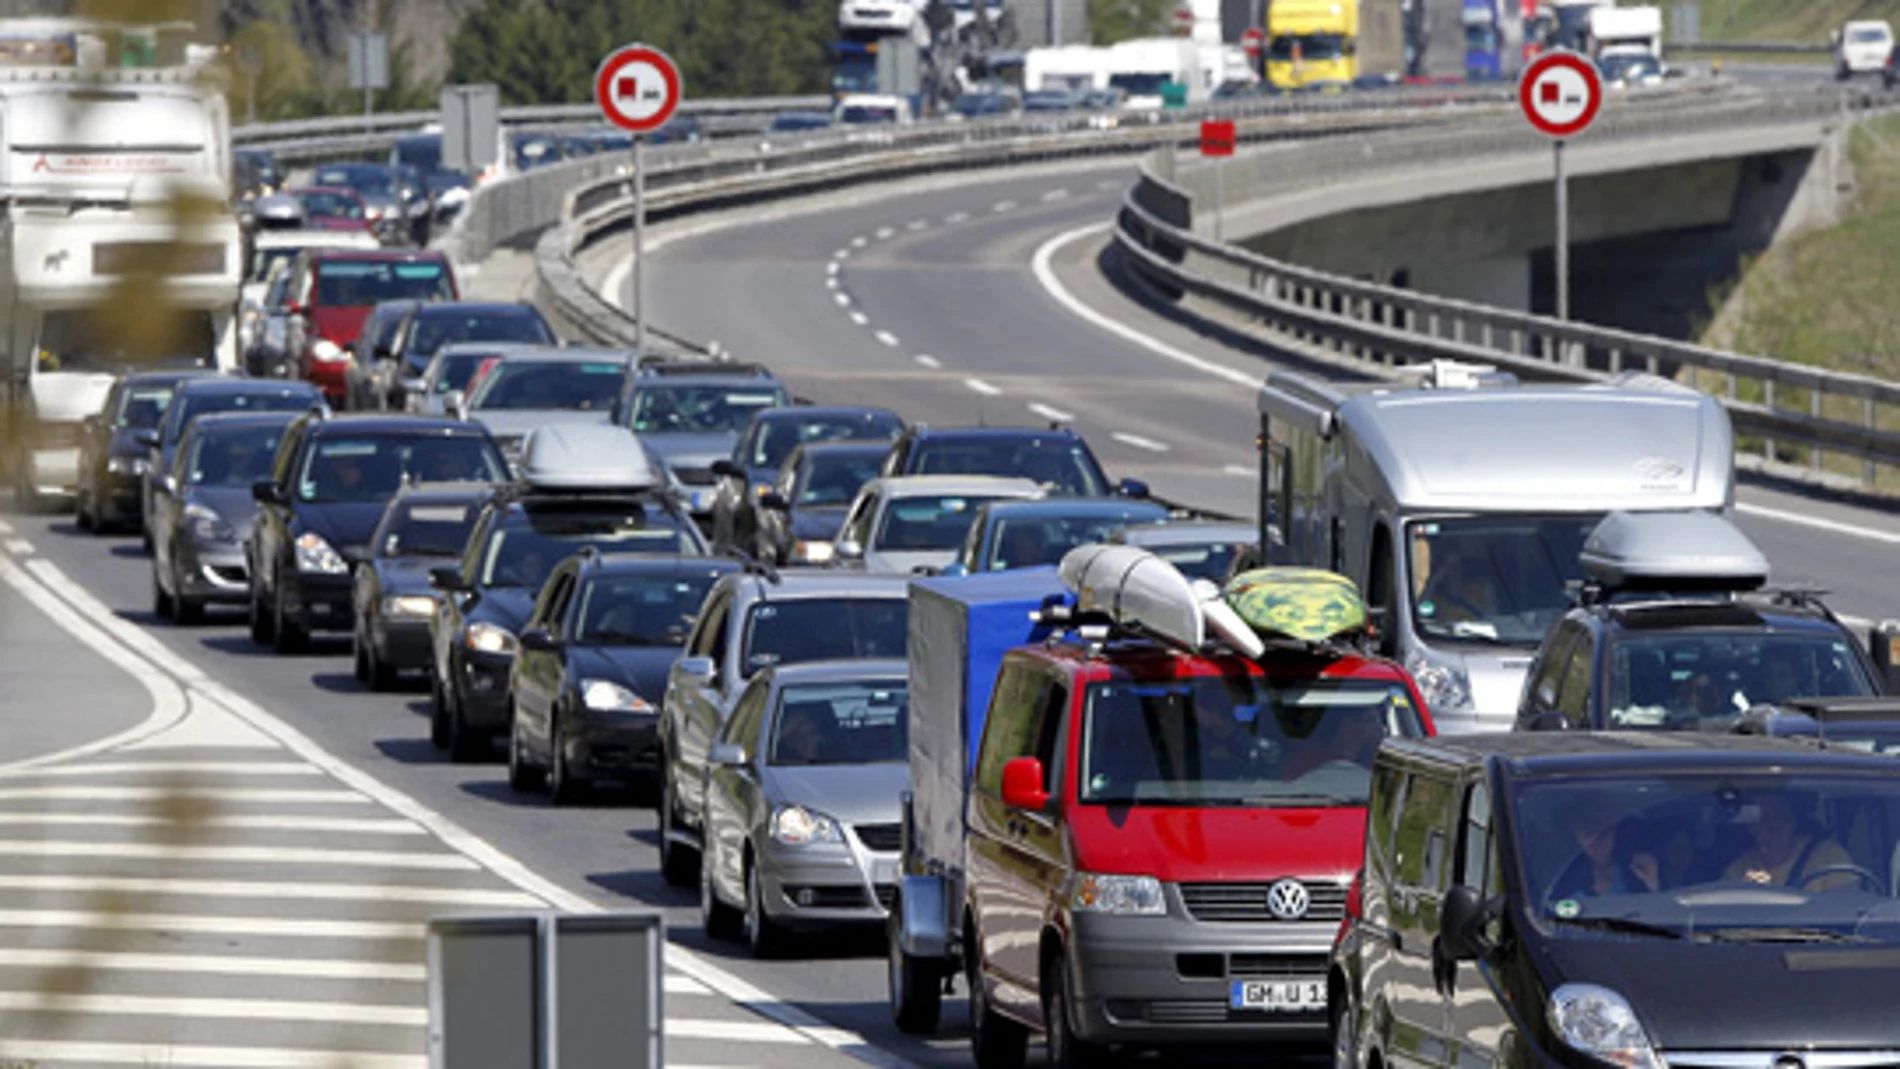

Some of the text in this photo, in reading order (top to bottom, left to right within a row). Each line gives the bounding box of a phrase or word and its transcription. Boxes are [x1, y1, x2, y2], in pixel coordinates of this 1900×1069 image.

[1269, 879, 1309, 919] VW
[1246, 983, 1274, 1003] GM
[1285, 983, 1300, 1003] U
